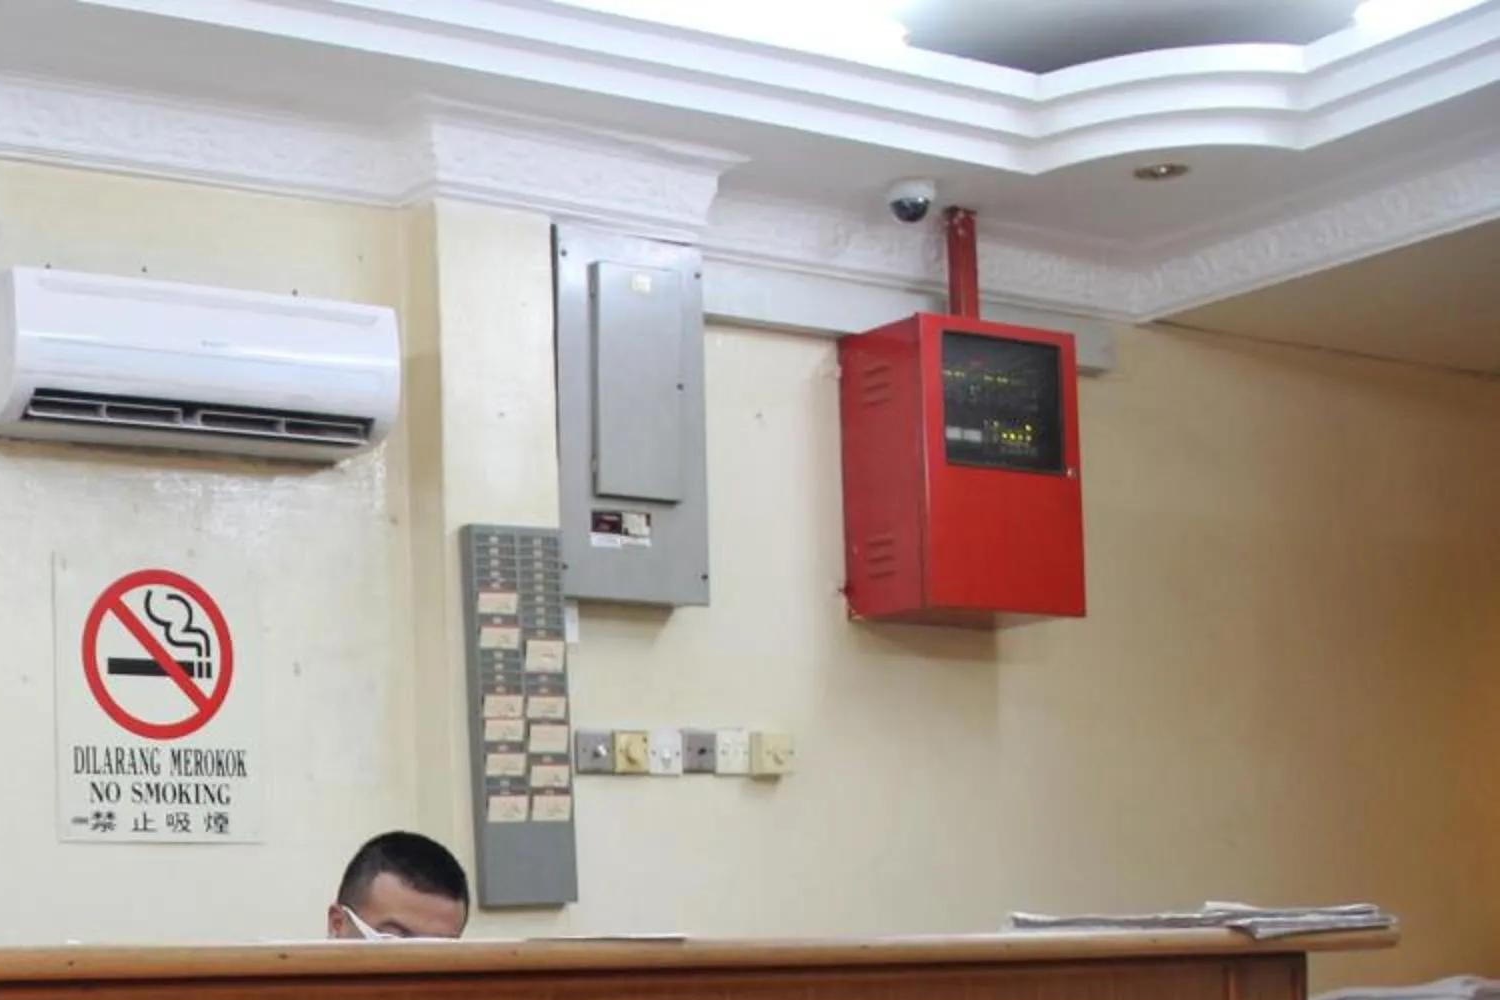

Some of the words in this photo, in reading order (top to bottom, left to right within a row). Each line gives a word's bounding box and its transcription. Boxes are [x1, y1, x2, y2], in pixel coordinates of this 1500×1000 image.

[73, 745, 162, 776] DILARANG
[169, 748, 248, 778] MEROKOK
[89, 780, 122, 804] NO
[131, 781, 232, 805] SMOKING
